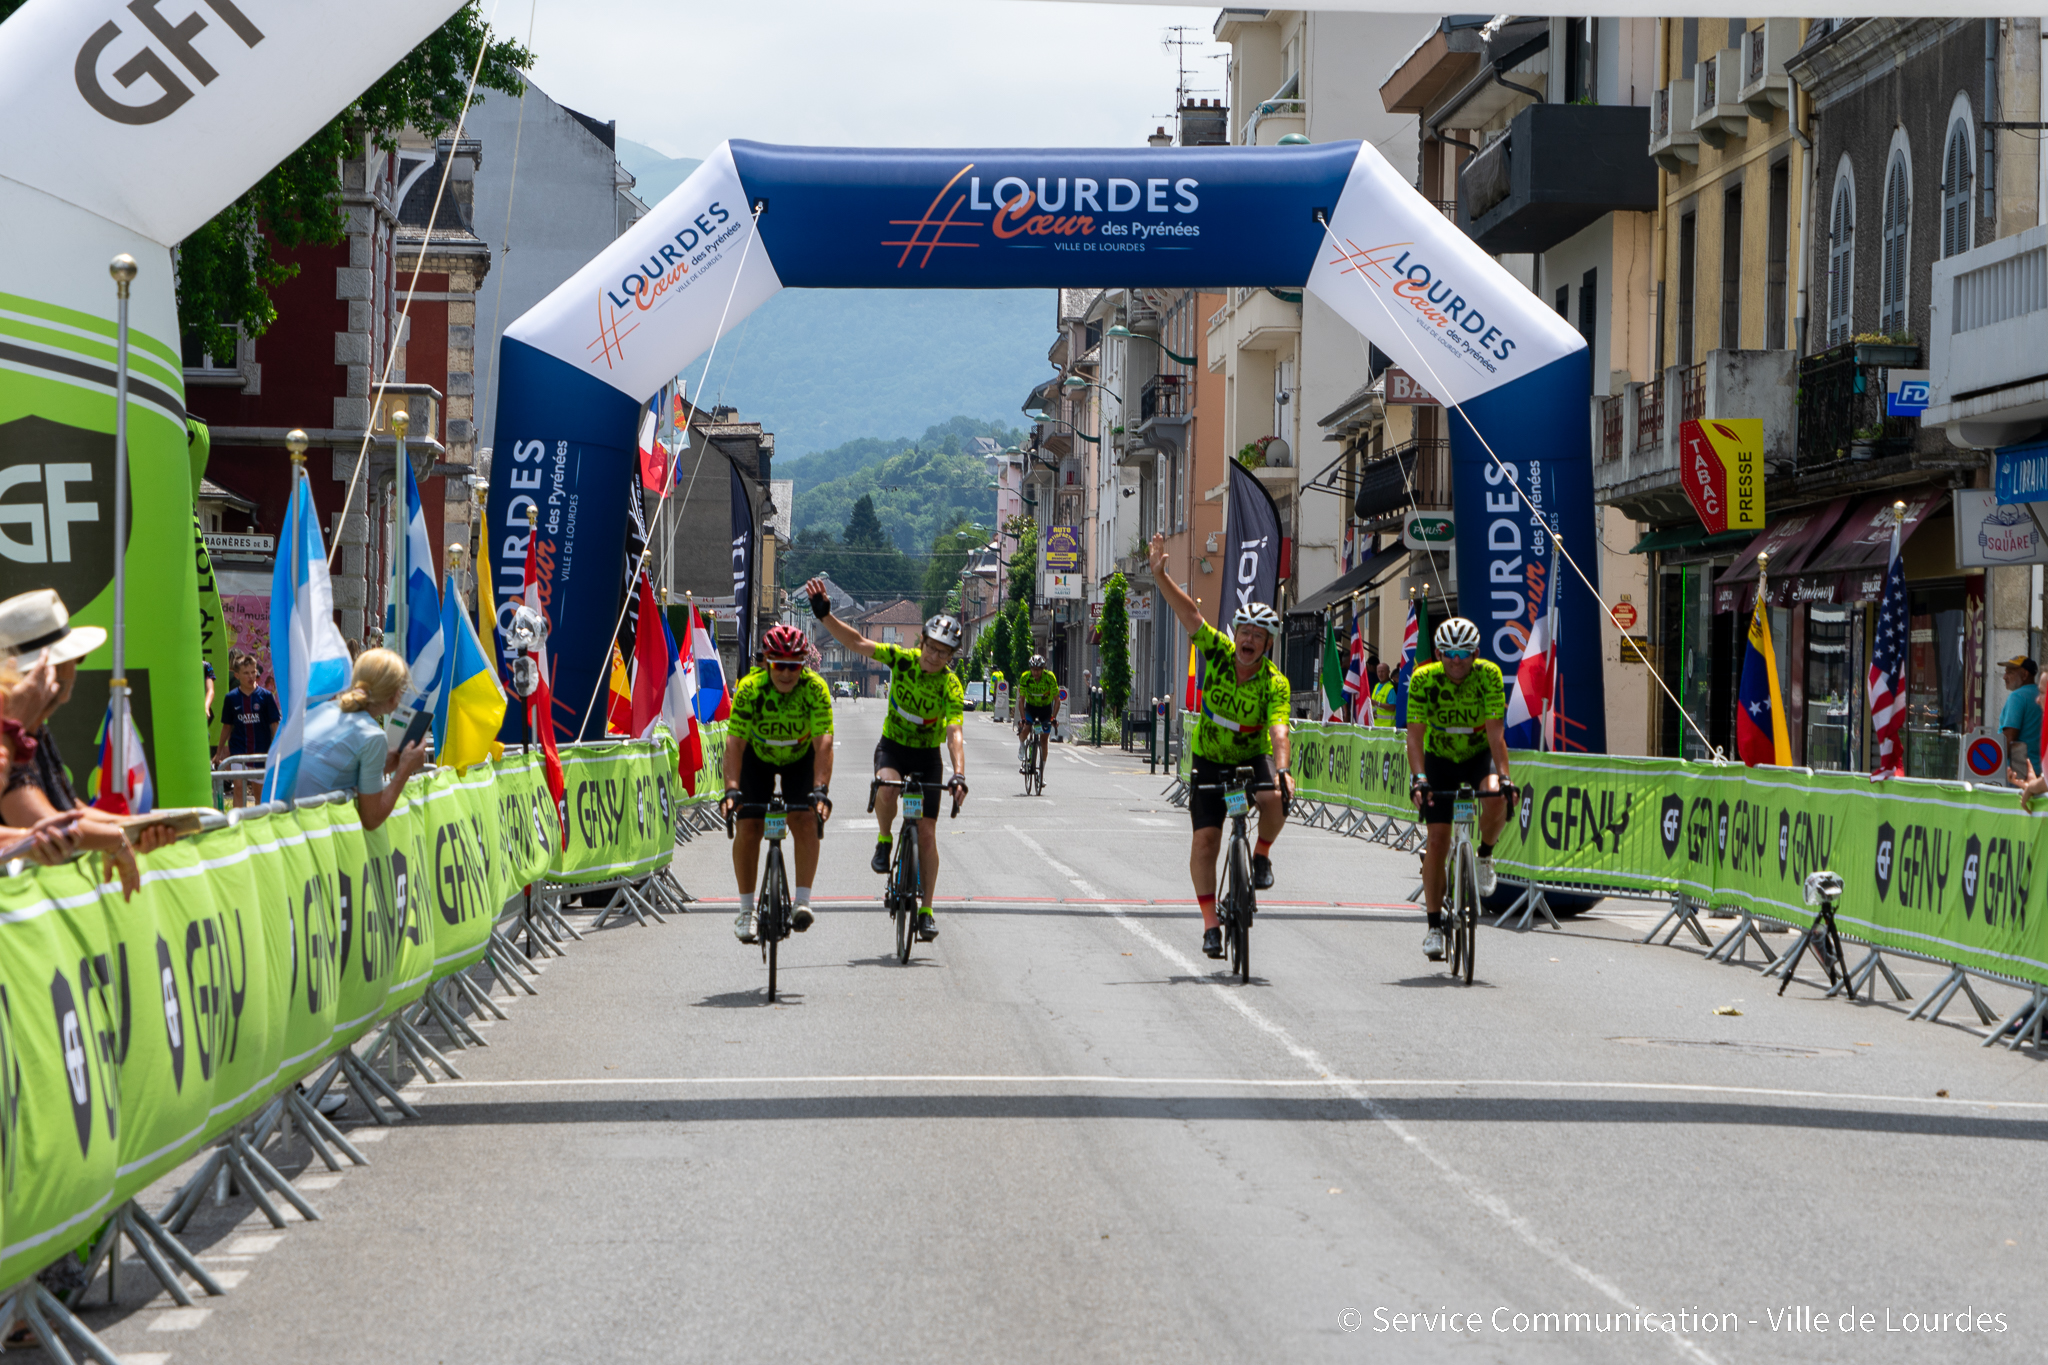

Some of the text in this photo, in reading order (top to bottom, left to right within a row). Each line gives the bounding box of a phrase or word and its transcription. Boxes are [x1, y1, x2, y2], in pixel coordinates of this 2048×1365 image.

[970, 176, 1200, 214] LOURDES
[691, 252, 707, 266] des
[705, 221, 742, 254] Pyrénées
[1101, 221, 1128, 236] des
[1132, 221, 1200, 239] Pyrénées
[607, 202, 729, 309] LOURDES
[1054, 242, 1146, 252] VILLE DE LOURDES
[676, 253, 723, 293] VILLE DE LOURDES
[1392, 251, 1516, 361] LOURDES
[1416, 317, 1462, 359] VILLE DE LOURDES
[1446, 329, 1462, 344] des
[1460, 340, 1498, 374] Pyrénées
[549, 439, 568, 507] Pyrénées
[1689, 438, 1719, 515] TABAC
[1738, 451, 1753, 522] PRESSE
[1530, 460, 1546, 526] Pyrénées
[545, 509, 561, 535] des
[2005, 529, 2013, 539] LE
[205, 536, 251, 547] BAGNÈRES
[263, 540, 271, 548] B.
[561, 494, 579, 582] VILLE DE LOURDES
[1530, 531, 1544, 556] des
[1988, 535, 2029, 552] SQUARE
[237, 603, 245, 613] la
[735, 680, 754, 708] GFNY
[809, 680, 832, 708] GFNY
[896, 684, 935, 714] GFNY
[1211, 688, 1255, 719] GFNY
[237, 713, 259, 722] QATAR
[758, 721, 805, 736] GFNY
[1437, 707, 1479, 724] GFNY
[577, 777, 626, 849] GFNY
[1229, 795, 1245, 804] 1195
[1456, 803, 1473, 811] 1194
[768, 819, 785, 827] 1193
[1541, 785, 1632, 854] GFNY
[1899, 824, 1952, 915] GFNY
[1984, 837, 2033, 932] GFNY
